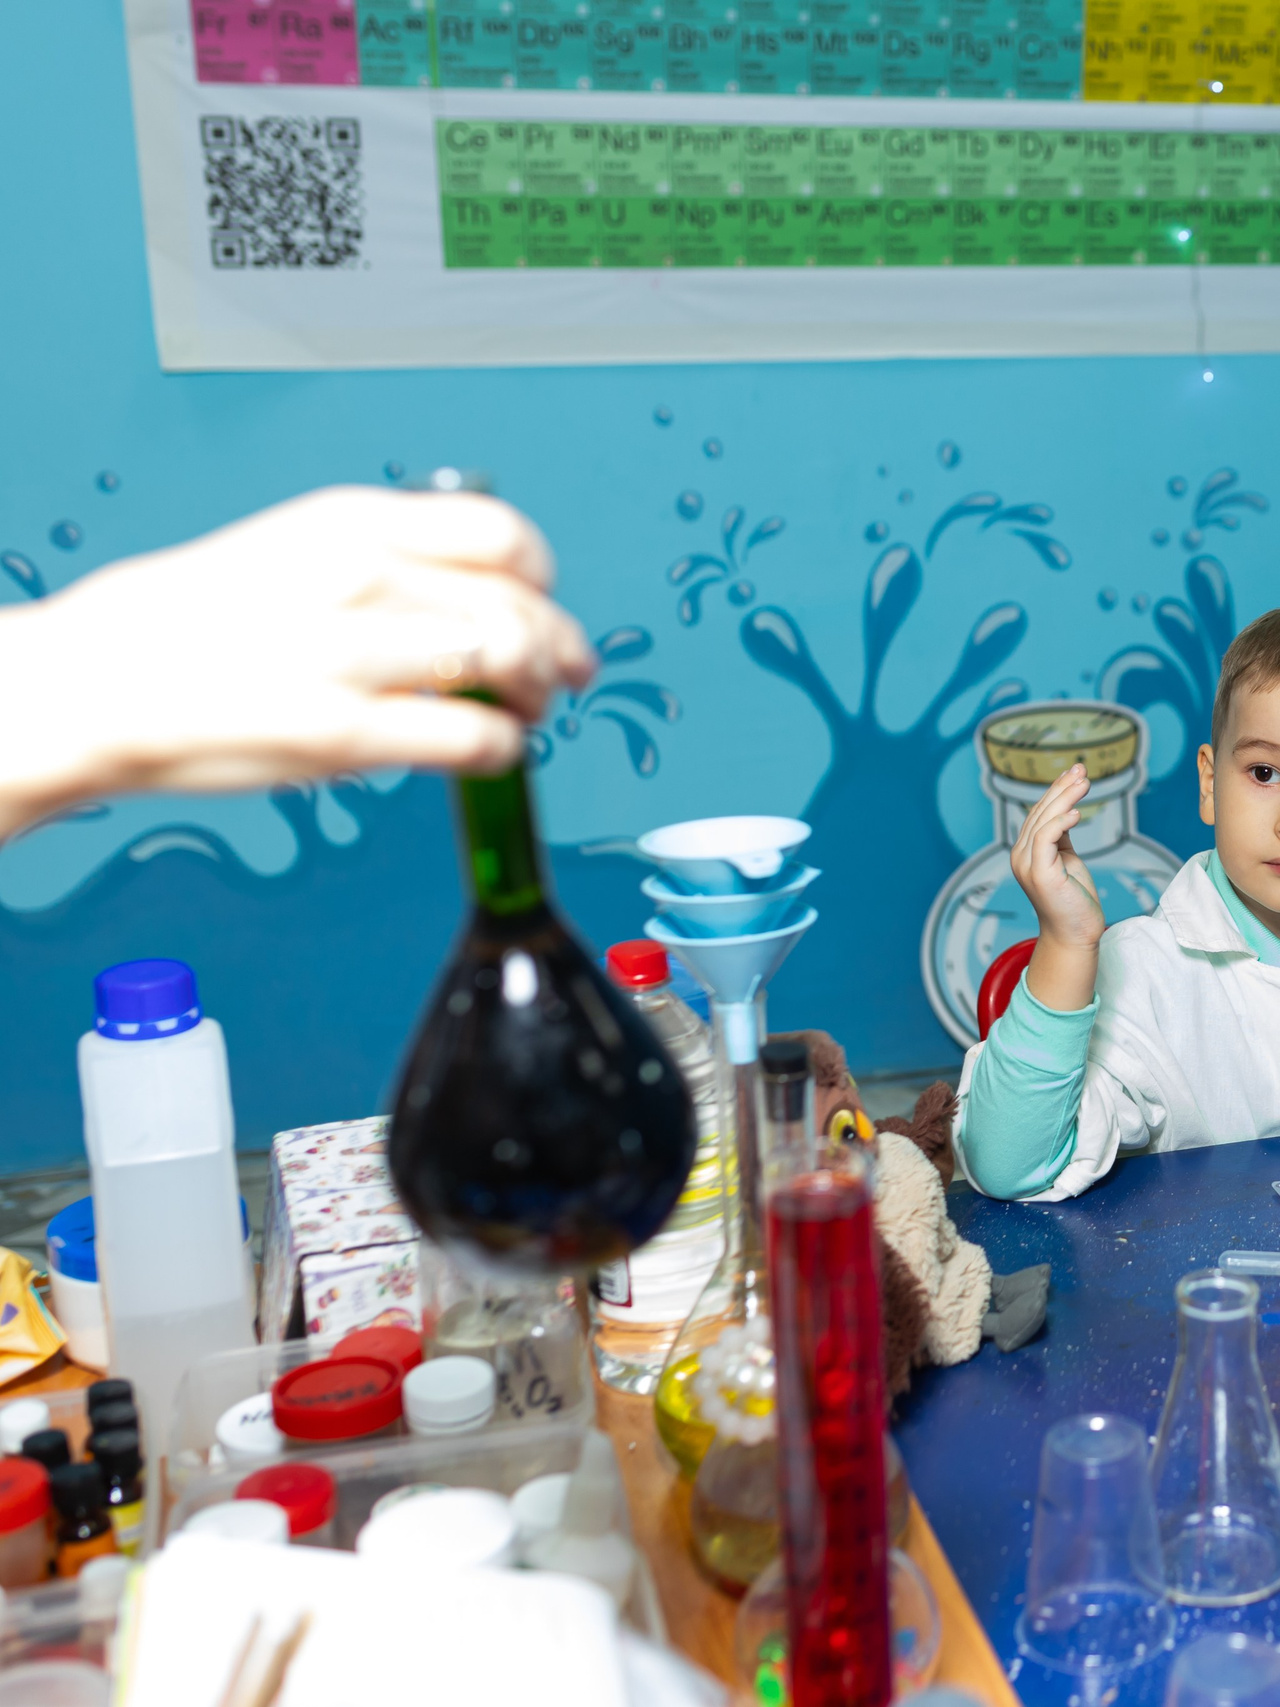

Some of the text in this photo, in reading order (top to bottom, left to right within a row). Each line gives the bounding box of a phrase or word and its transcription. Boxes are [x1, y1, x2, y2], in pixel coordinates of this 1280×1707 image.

[279, 10, 324, 42] Ra
[361, 13, 402, 43] Ac
[517, 18, 560, 49] Db
[593, 20, 635, 58] Sg
[740, 27, 780, 55] Hs
[883, 30, 921, 58] Ds
[952, 31, 992, 67] Rg
[1019, 33, 1059, 62] Cn
[445, 121, 490, 153] Ce
[523, 123, 555, 153] Pr
[599, 125, 641, 154] Nd
[672, 126, 721, 155] Pm
[743, 126, 793, 157] Sm
[815, 128, 854, 157] Eu
[884, 128, 926, 158] Gd
[956, 130, 990, 159] Tb
[1019, 131, 1057, 164] Dy
[1083, 132, 1122, 159] Ho
[1148, 133, 1177, 160] Er
[450, 198, 492, 226] Th
[527, 198, 567, 228] Pa
[601, 198, 627, 228] U
[675, 199, 717, 230] Np
[747, 199, 785, 228] Pu
[817, 200, 864, 228] Am
[885, 200, 933, 229] Cm
[1019, 200, 1051, 229] Cf
[1083, 201, 1120, 229] Es
